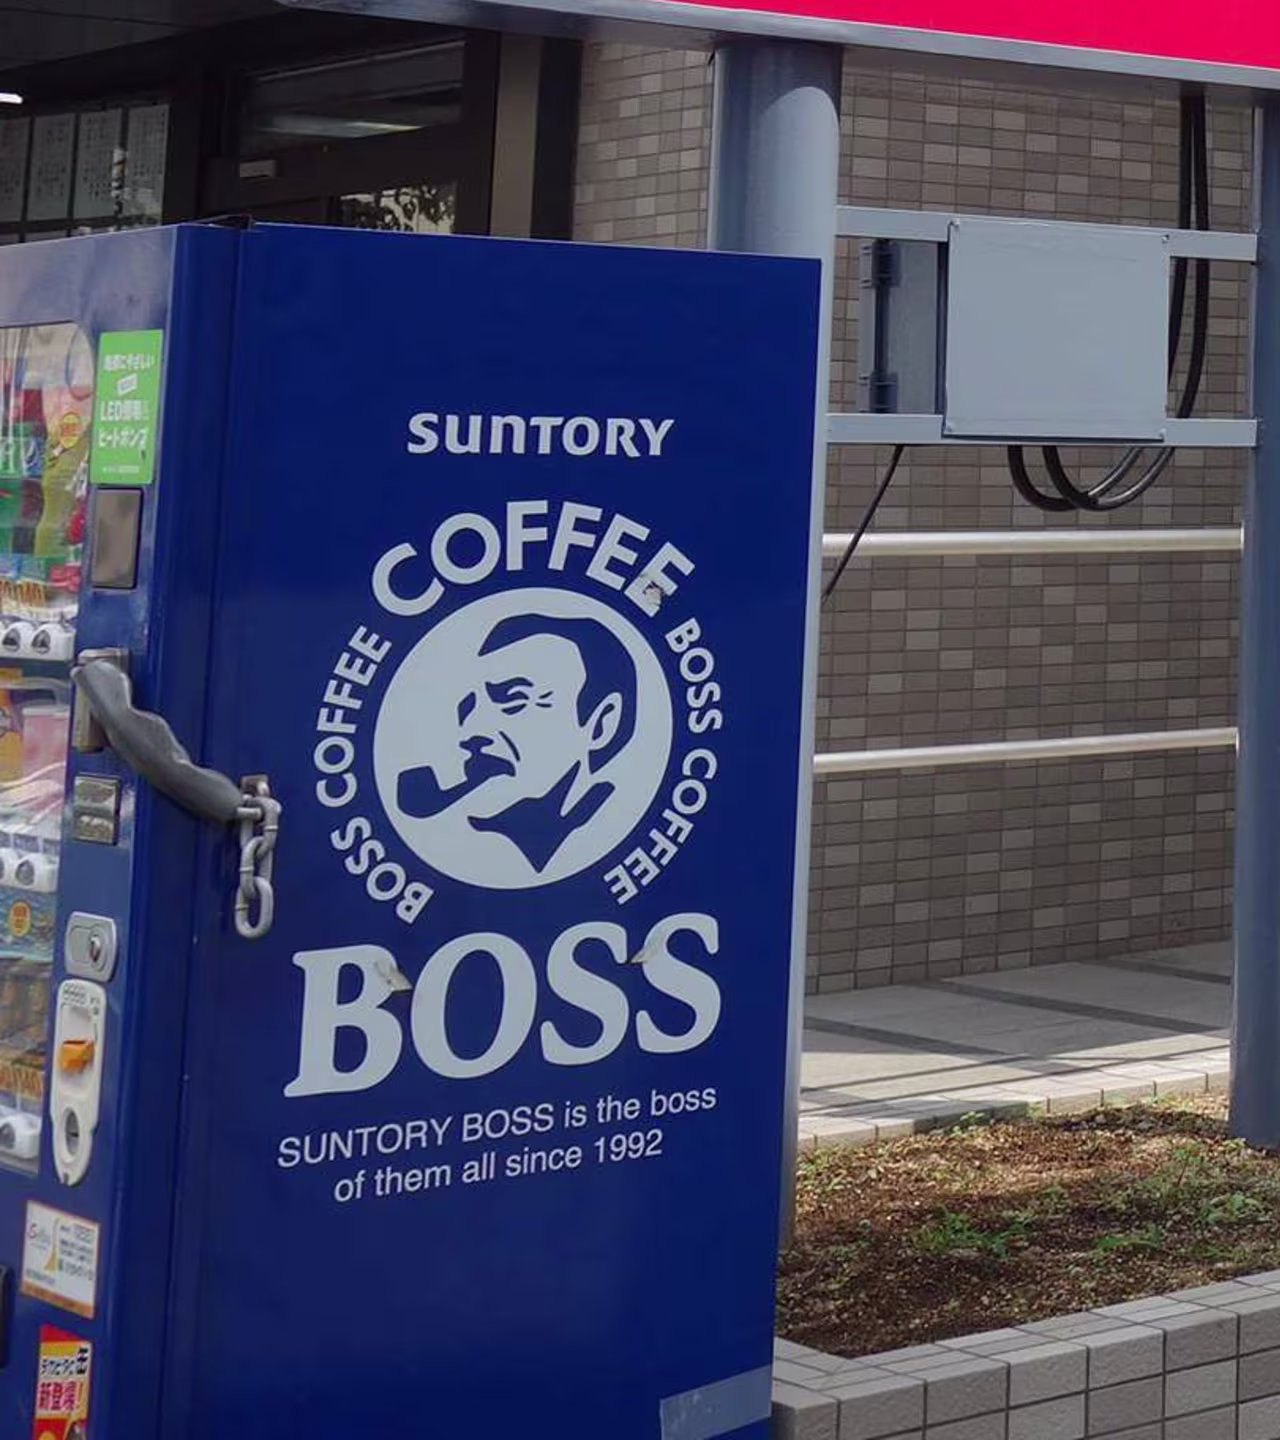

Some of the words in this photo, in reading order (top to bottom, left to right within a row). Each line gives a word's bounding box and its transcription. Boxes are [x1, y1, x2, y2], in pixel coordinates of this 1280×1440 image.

[406, 412, 675, 458] SUNTORY
[371, 499, 696, 621] COFFEE
[311, 623, 392, 809] COFFEE
[664, 616, 724, 734] BOSS
[330, 814, 434, 925] BOSS
[604, 746, 719, 905] COFFEE
[283, 912, 722, 1098] BOSS
[277, 1116, 453, 1169] SUNTORY
[461, 1102, 555, 1143] BOSS
[564, 1100, 589, 1130] is
[596, 1095, 641, 1126] the
[650, 1086, 718, 1117] boss
[333, 1170, 370, 1203] of
[375, 1161, 453, 1197] them
[461, 1152, 497, 1184] all
[505, 1143, 583, 1178] since
[594, 1128, 664, 1165] 1992
